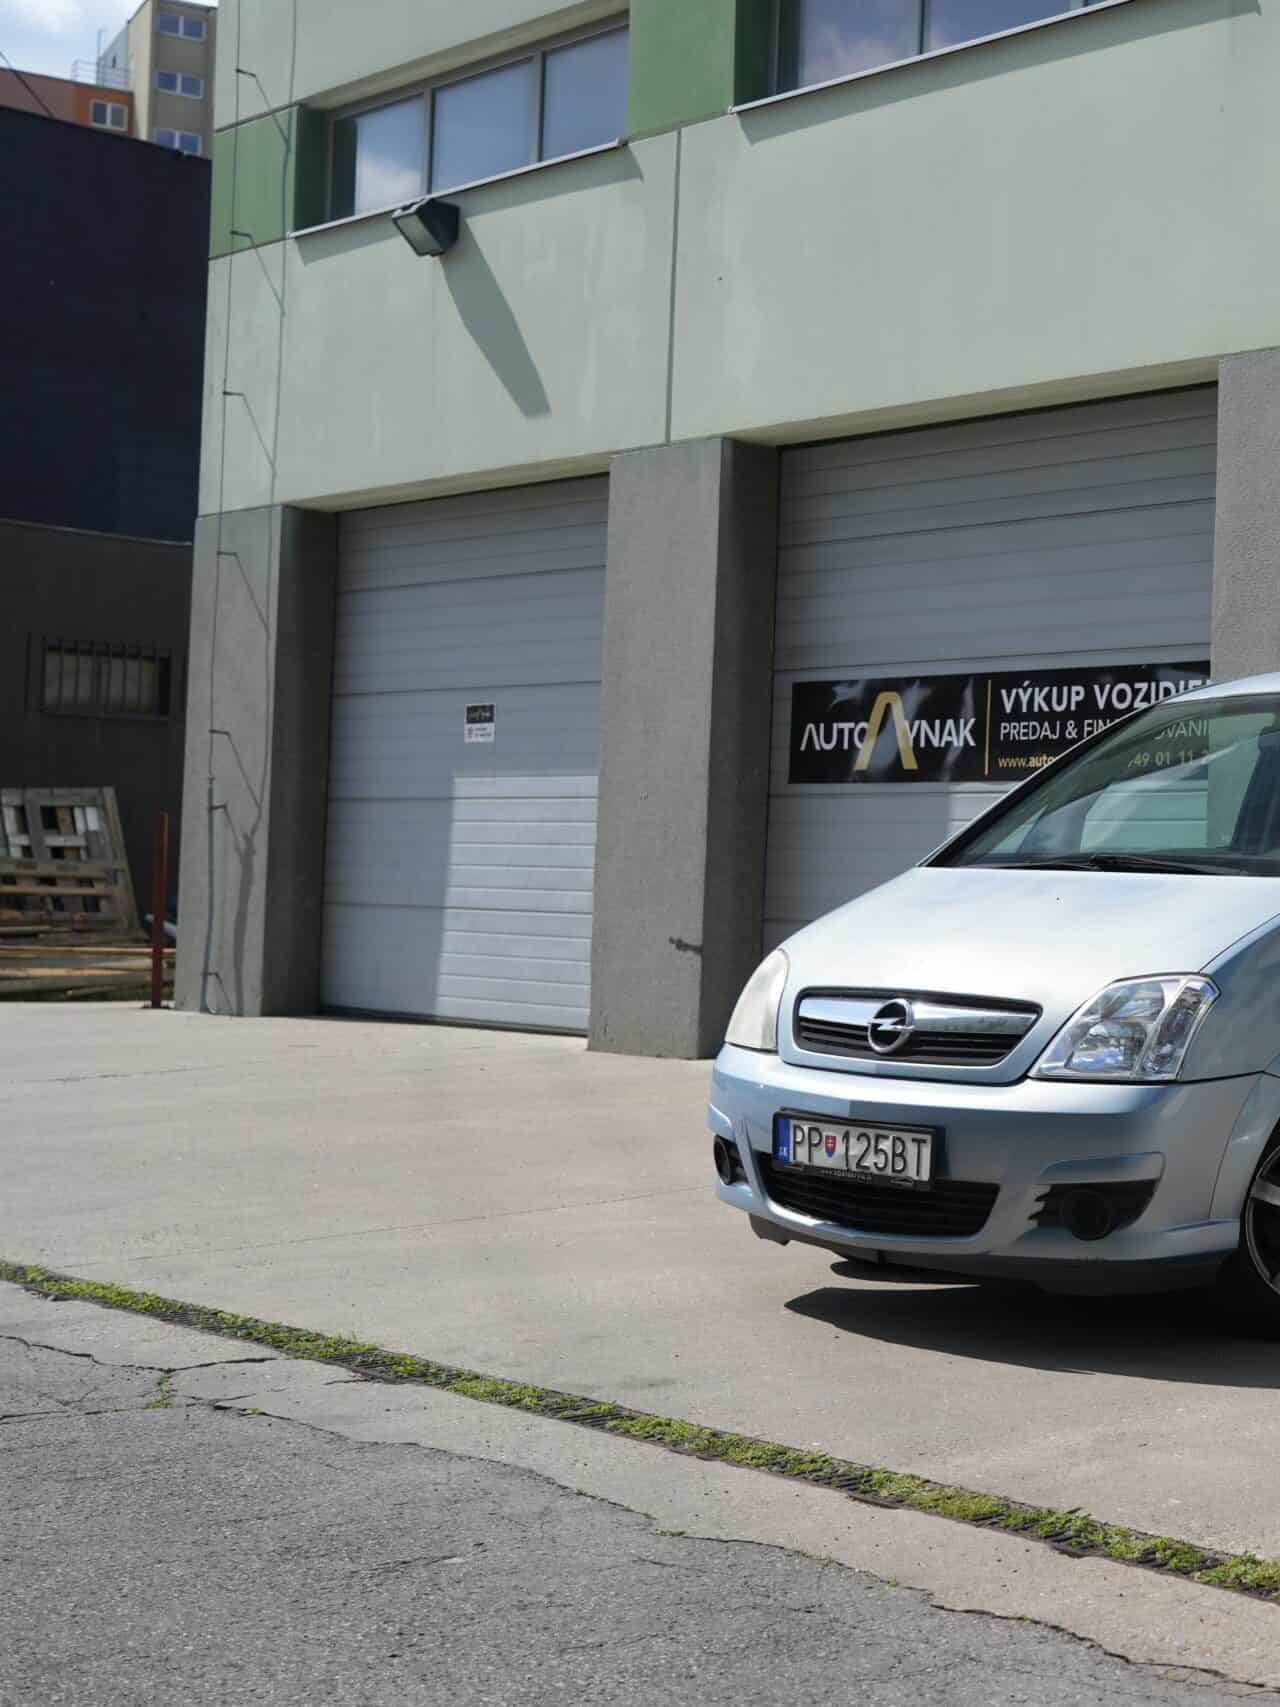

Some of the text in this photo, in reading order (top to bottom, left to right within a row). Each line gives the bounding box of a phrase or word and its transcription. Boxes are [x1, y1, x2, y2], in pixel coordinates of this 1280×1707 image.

[1001, 679, 1211, 713] VÝKUP VOZIDI
[1000, 720, 1060, 741] PREDAJ
[1065, 720, 1078, 739] &
[793, 1124, 928, 1177] PP 125BT
